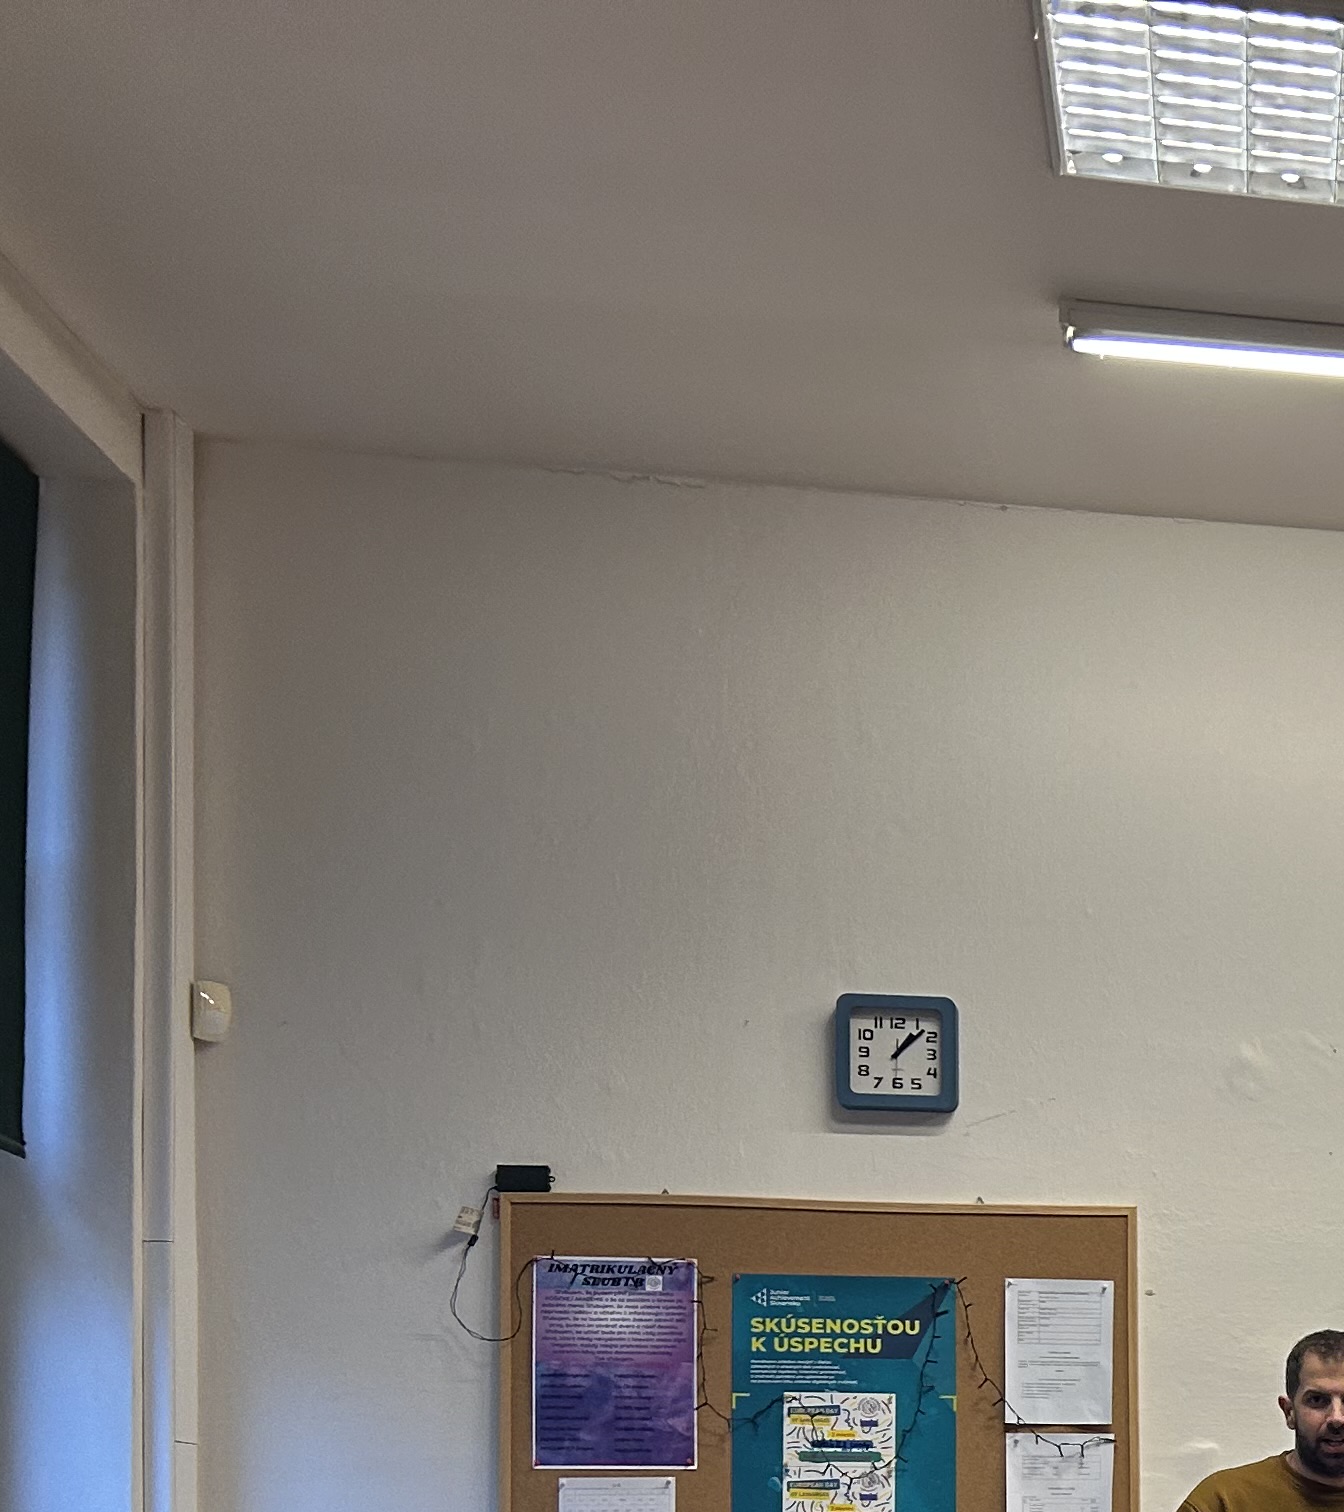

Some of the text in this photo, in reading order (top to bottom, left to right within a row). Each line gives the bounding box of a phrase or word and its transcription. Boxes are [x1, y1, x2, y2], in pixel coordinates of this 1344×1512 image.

[874, 1016, 883, 1029] 11
[890, 1017, 906, 1029] 12
[858, 1028, 874, 1041] 10
[926, 1031, 938, 1043] 2
[858, 1046, 870, 1058] 9
[926, 1048, 937, 1061] 3
[857, 1064, 870, 1077] 8
[926, 1067, 937, 1079] 4
[873, 1076, 922, 1090] 7 6 5
[750, 1313, 921, 1336] SKÚSENOSŤOU
[751, 1333, 883, 1354] K ÚSPECHU
